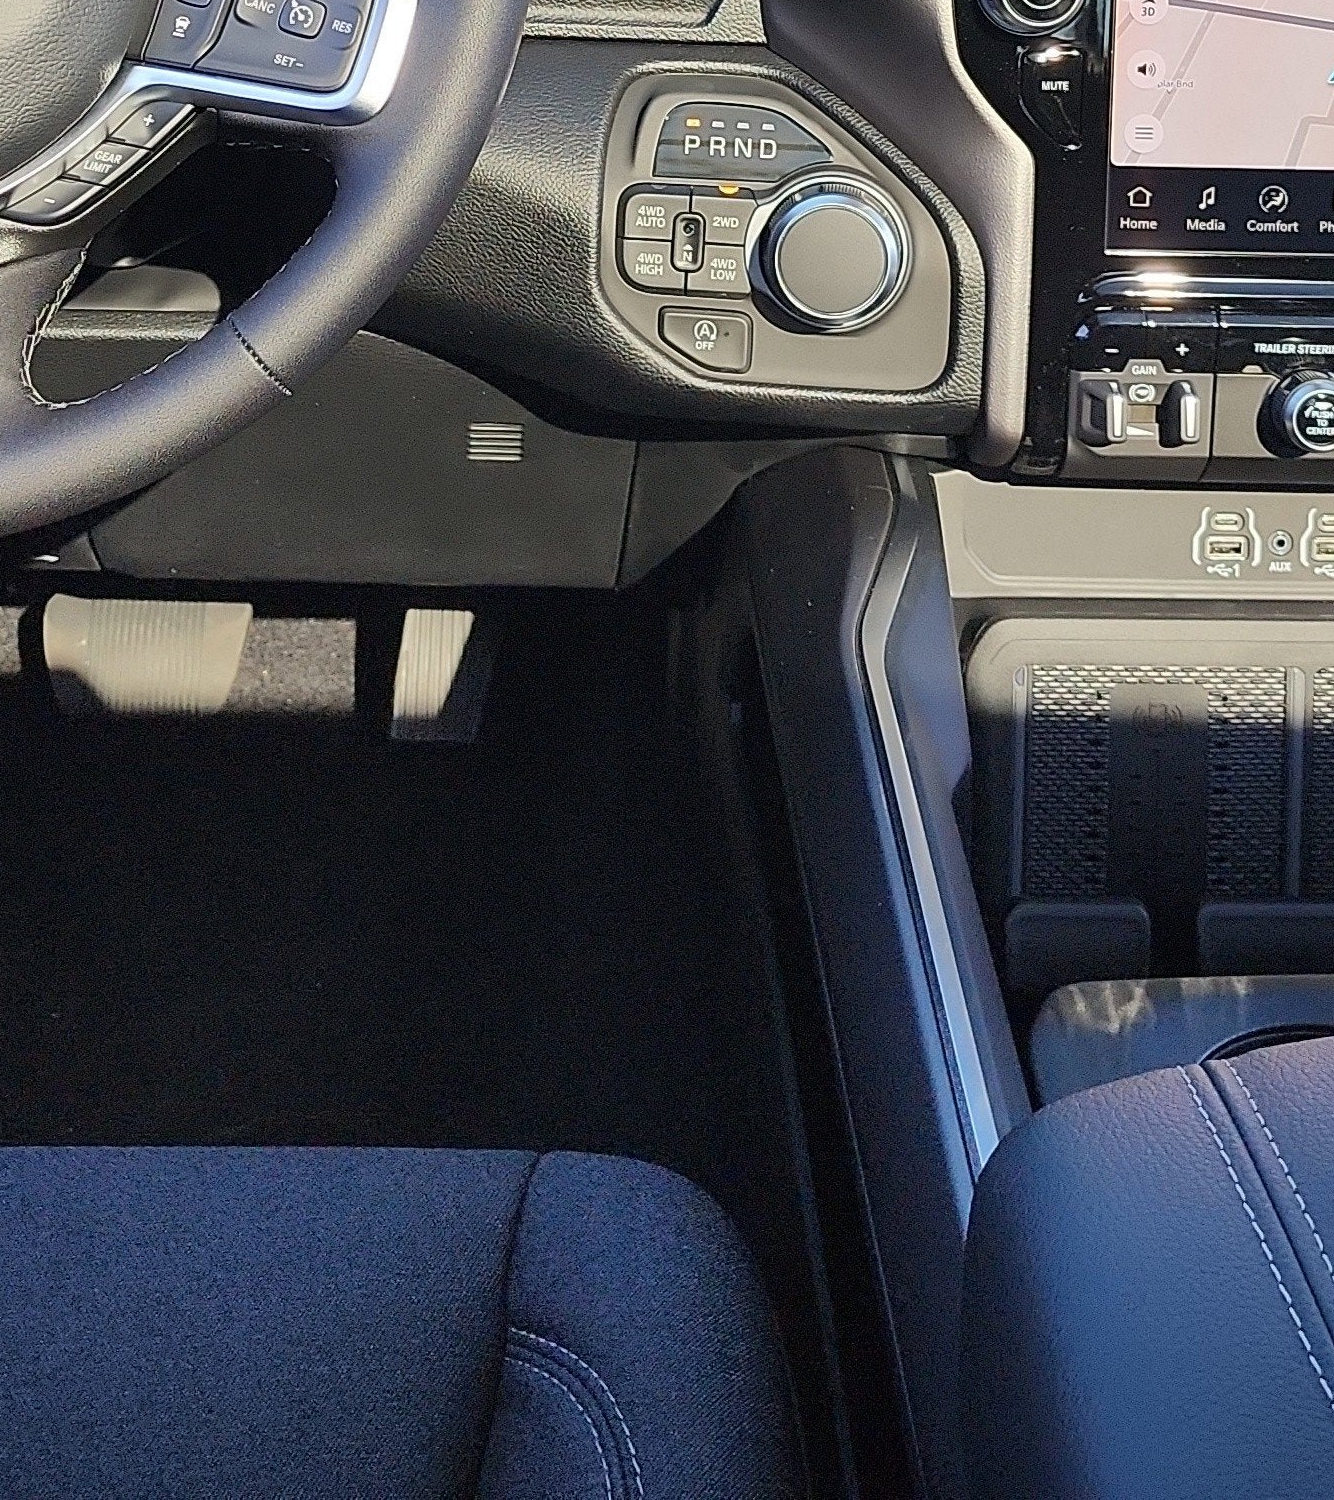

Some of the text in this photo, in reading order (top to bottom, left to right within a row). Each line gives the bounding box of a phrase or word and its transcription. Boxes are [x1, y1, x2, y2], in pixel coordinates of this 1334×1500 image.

[1140, 6, 1155, 17] 3D
[331, 19, 354, 35] RES
[1041, 81, 1069, 91] MUTE
[94, 150, 123, 166] GEAR
[83, 160, 113, 174] LIMIT
[637, 206, 665, 218] 4WD
[635, 216, 666, 228] AUTO
[713, 216, 739, 229] 2WD
[1120, 217, 1158, 231] Home
[1186, 218, 1225, 232] Media
[1247, 219, 1299, 234] Comfort
[637, 252, 664, 265] 4WD
[682, 249, 693, 264] N
[635, 263, 664, 277] HIGH
[710, 257, 738, 270] 4WD
[710, 268, 737, 282] LOW
[695, 340, 715, 351] OFF
[1254, 342, 1296, 355] TRAILER
[1131, 365, 1157, 376] GAIN
[1312, 410, 1334, 419] PUSH
[1317, 419, 1329, 427] TO
[1233, 565, 1241, 578] 1
[1269, 561, 1292, 573] AUX
